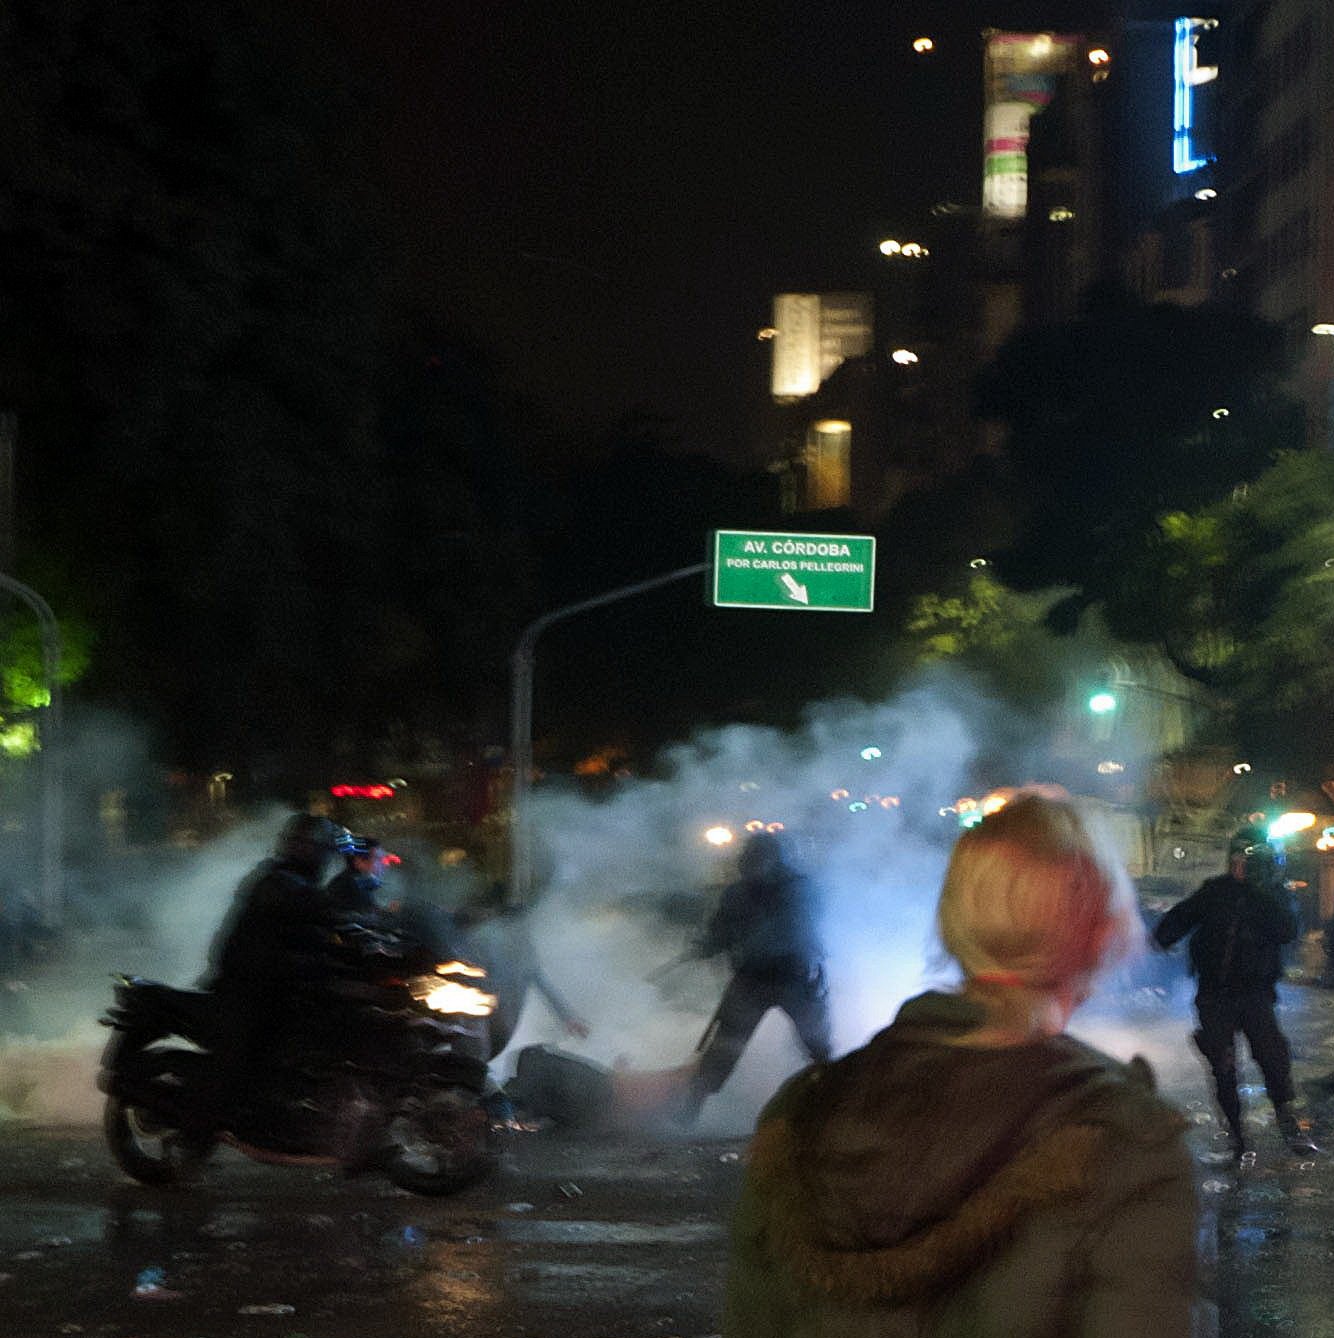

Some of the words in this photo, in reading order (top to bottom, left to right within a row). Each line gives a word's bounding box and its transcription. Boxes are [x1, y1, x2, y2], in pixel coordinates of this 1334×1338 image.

[743, 540, 767, 554] AV.
[772, 539, 851, 557] CÓRDOBA
[726, 558, 750, 569] POR
[753, 559, 798, 571] CARLOS
[799, 561, 865, 573] PELLEGRINI
